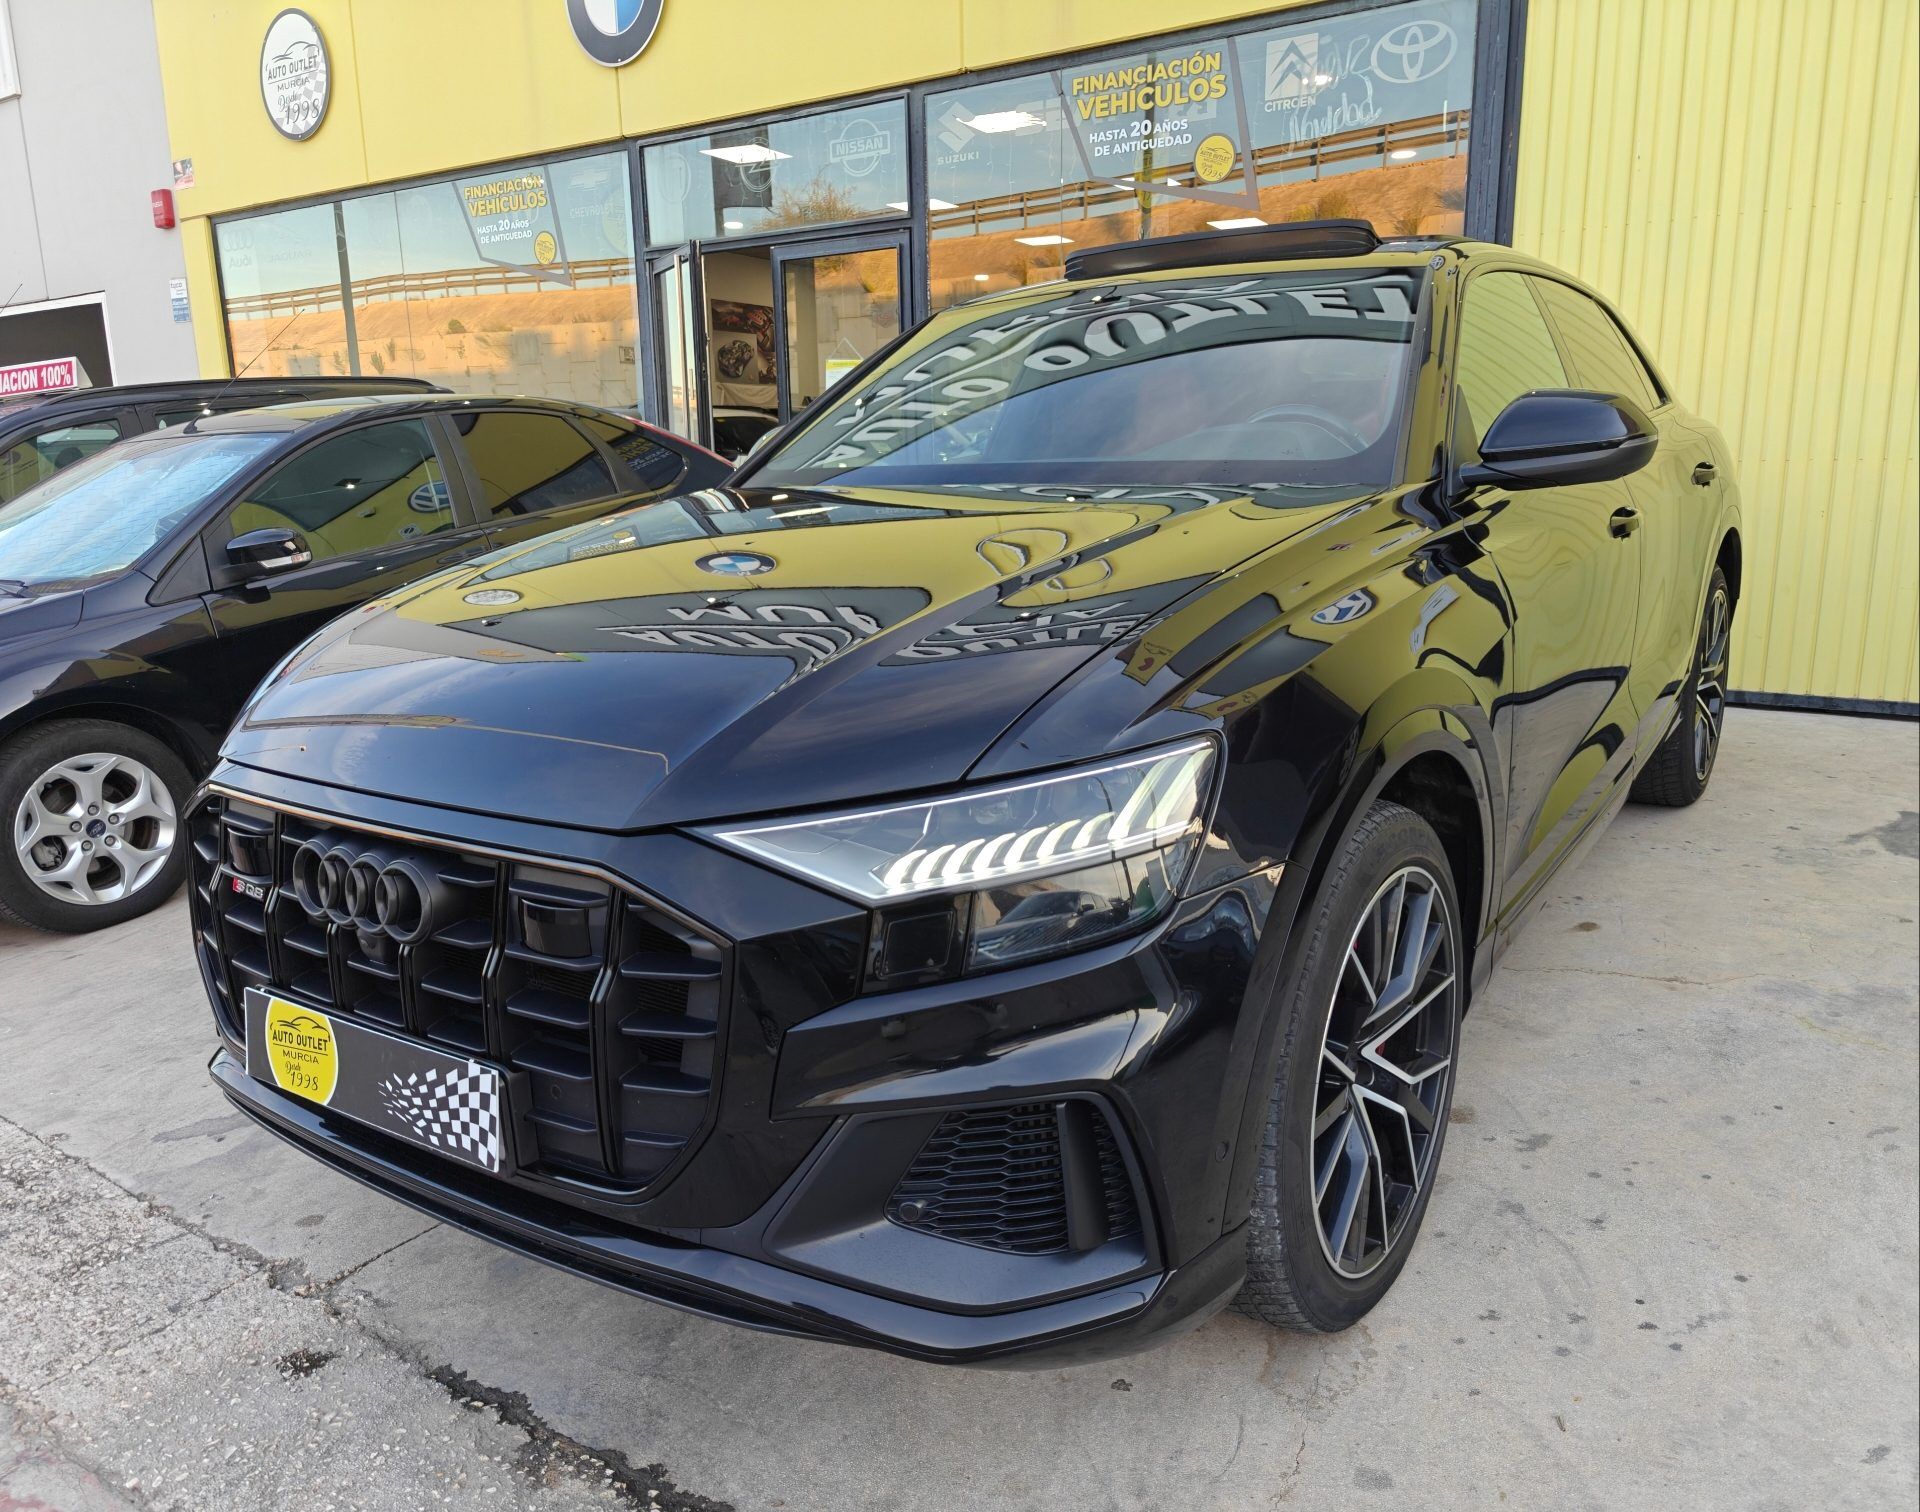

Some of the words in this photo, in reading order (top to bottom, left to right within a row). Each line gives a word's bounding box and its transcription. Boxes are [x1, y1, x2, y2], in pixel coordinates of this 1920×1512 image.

[268, 65, 287, 81] AUTO
[289, 55, 318, 73] OUTLET
[1072, 51, 1222, 96] FINANCIACIÓN
[277, 76, 310, 92] MURCIA
[1077, 74, 1227, 121] VEHÍCULOS
[285, 98, 319, 125] 1998
[1089, 128, 1128, 144] HASTA
[1130, 120, 1152, 137] 20
[1153, 118, 1188, 133] AÑOS
[835, 136, 883, 156] NISSAN
[1094, 146, 1111, 157] DE
[1112, 133, 1192, 155] ANTIGUEDAD
[937, 151, 980, 166] SUZUKI
[464, 173, 544, 200] FINANCIACIÓN
[468, 189, 548, 217] VEHÍCULOS
[477, 224, 498, 235] HASTA
[498, 219, 511, 231] 20
[511, 219, 529, 229] AÑOS
[480, 235, 490, 244] DE
[491, 230, 533, 244] ANTIGUEDAD
[41, 363, 71, 388] 100%
[236, 879, 264, 899] SQ8
[272, 1029, 294, 1044] AUTO
[296, 1035, 328, 1052] OUTLET
[282, 1049, 319, 1065] MURCIA
[290, 1071, 319, 1091] 1998
